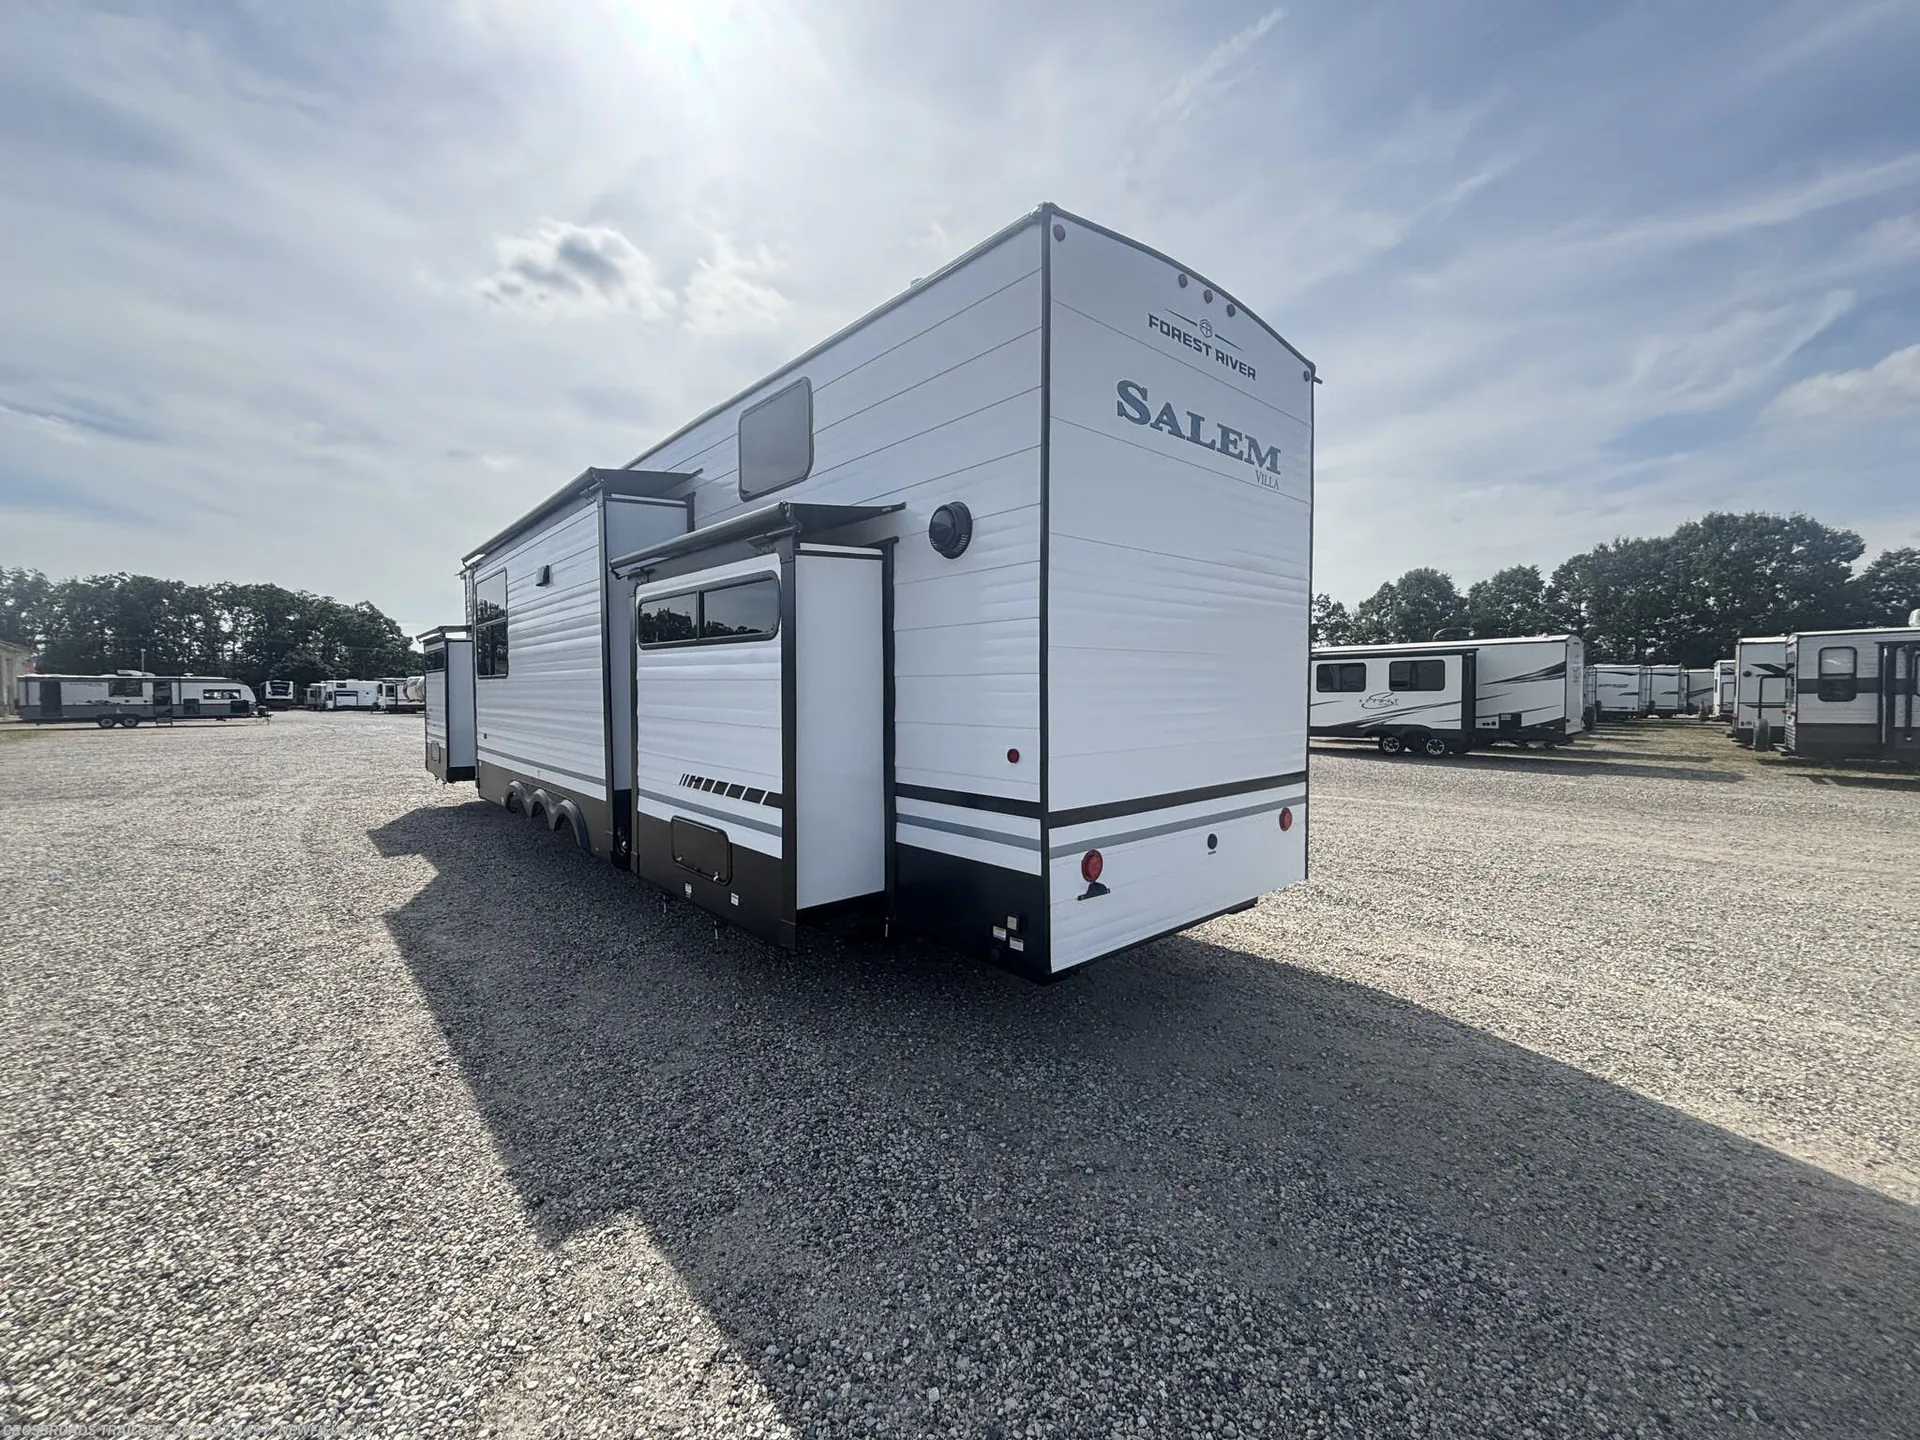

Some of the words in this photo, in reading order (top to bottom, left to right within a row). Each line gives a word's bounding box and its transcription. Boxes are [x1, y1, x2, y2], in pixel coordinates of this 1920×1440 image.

[1148, 313, 1212, 357] FOREST
[1215, 348, 1257, 381] RIVER
[1116, 379, 1282, 475] SALEM
[1255, 470, 1280, 490] VILLA
